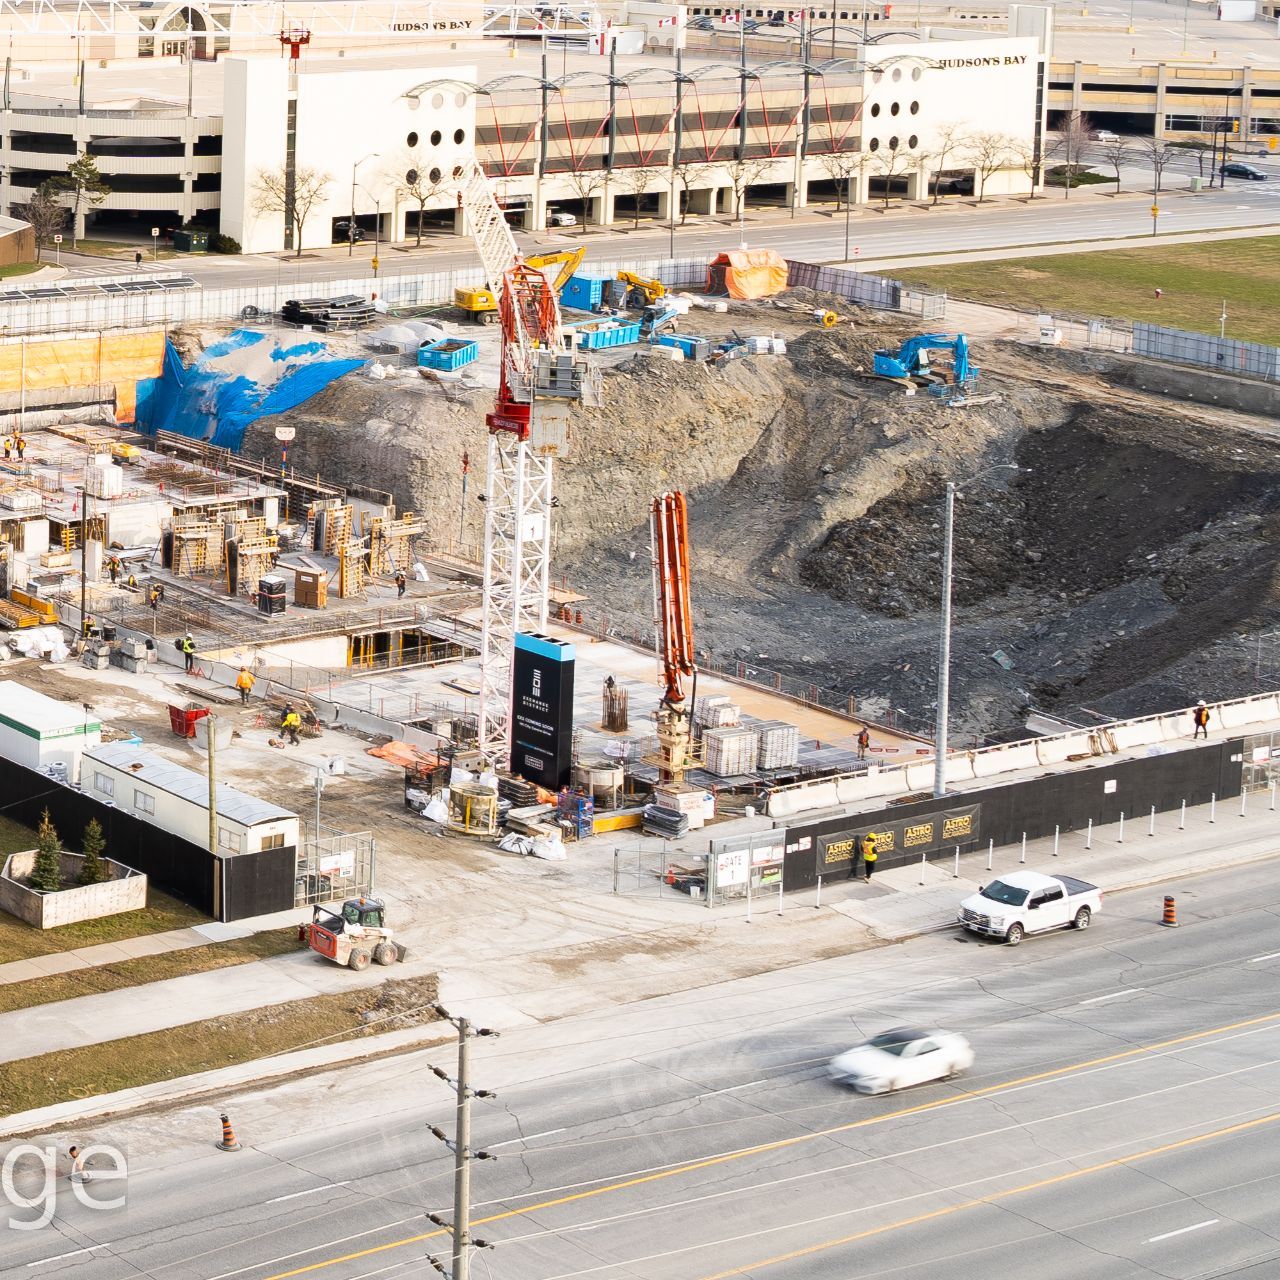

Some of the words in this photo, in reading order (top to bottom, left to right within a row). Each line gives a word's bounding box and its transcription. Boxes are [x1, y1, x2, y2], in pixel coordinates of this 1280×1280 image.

[449, 20, 473, 30] BAY
[939, 57, 1001, 69] HUDSON'S
[1003, 55, 1028, 66] BAY
[522, 700, 549, 713] DISTRICT
[945, 817, 971, 830] ASTRO
[906, 826, 932, 838] ASTRO
[874, 834, 894, 846] STRO
[827, 842, 854, 854] ASTRO
